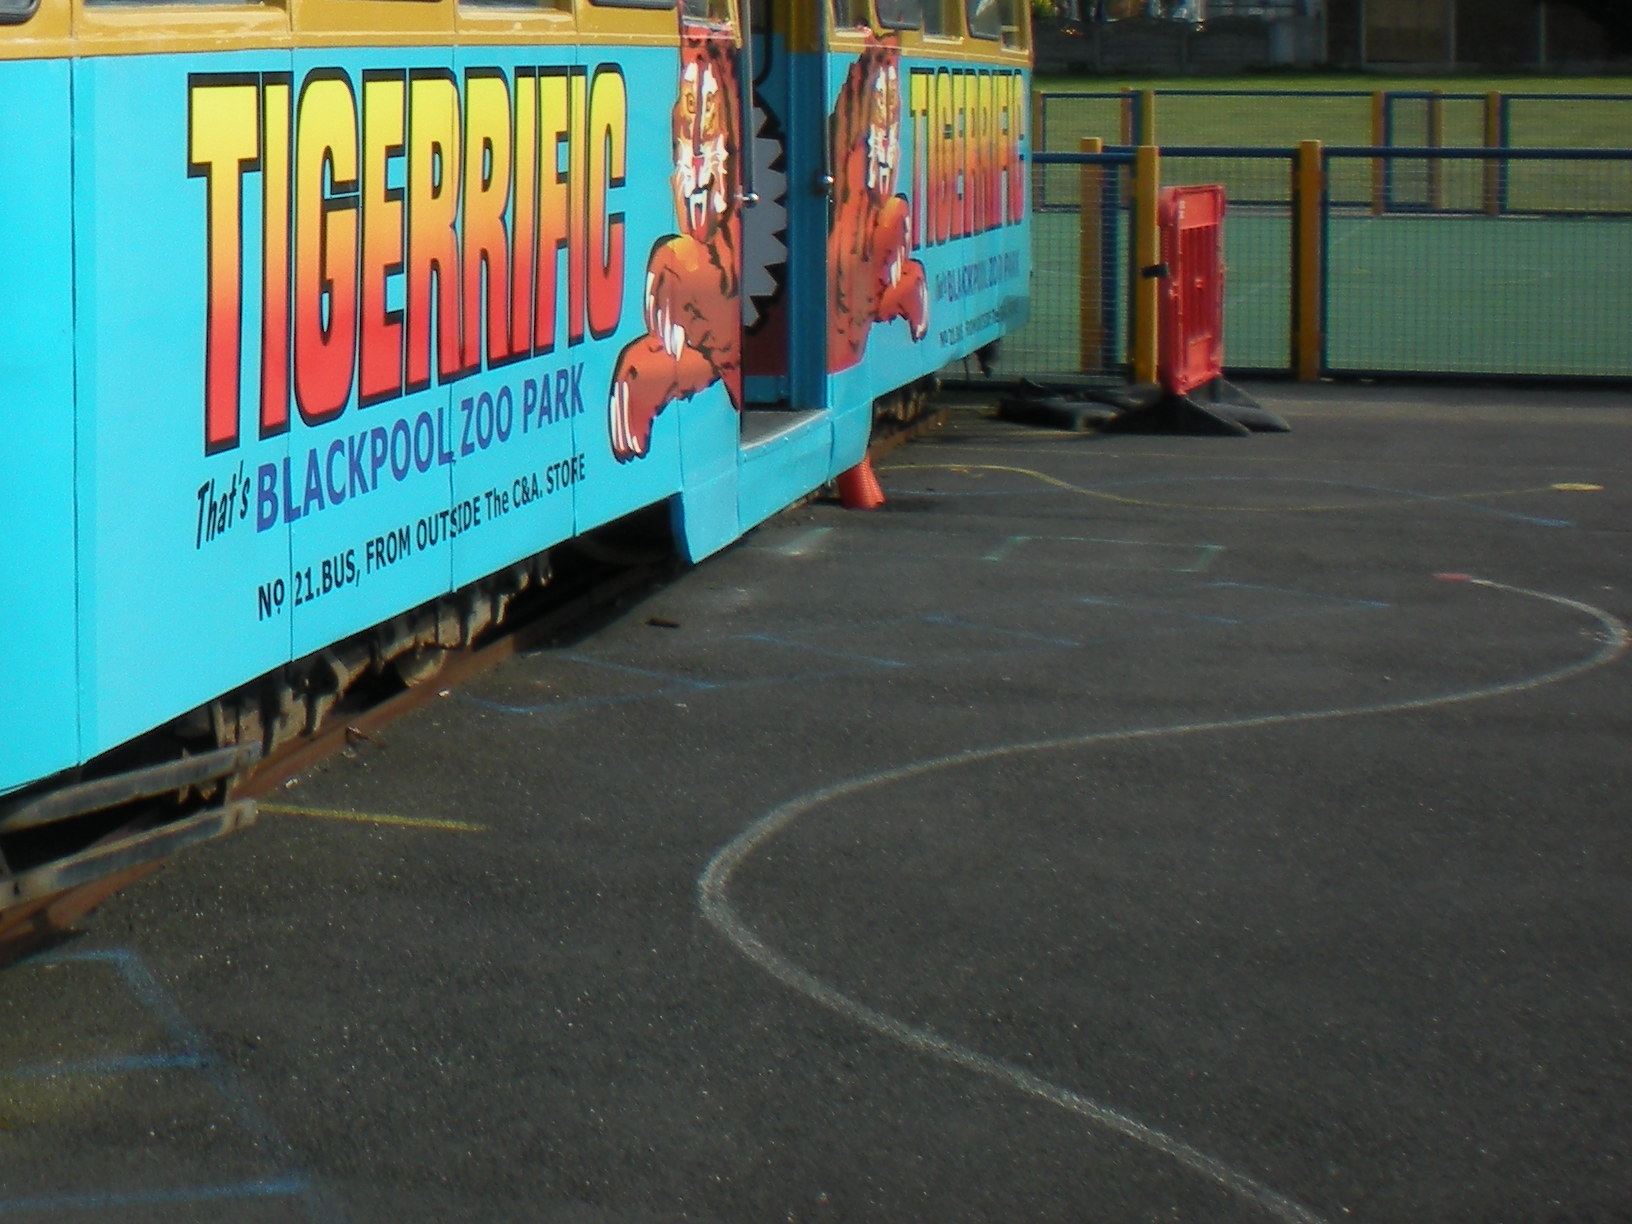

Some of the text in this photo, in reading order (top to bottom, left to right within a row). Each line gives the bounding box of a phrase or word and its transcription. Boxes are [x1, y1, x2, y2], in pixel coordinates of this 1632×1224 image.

[187, 62, 627, 457] TIGERRIFIC
[197, 362, 585, 550] That's BLACKPOOL ZOO PARK
[366, 524, 411, 574] FROM
[416, 495, 481, 551] OUTSIDE
[485, 487, 509, 520] The
[546, 453, 585, 494] STORE
